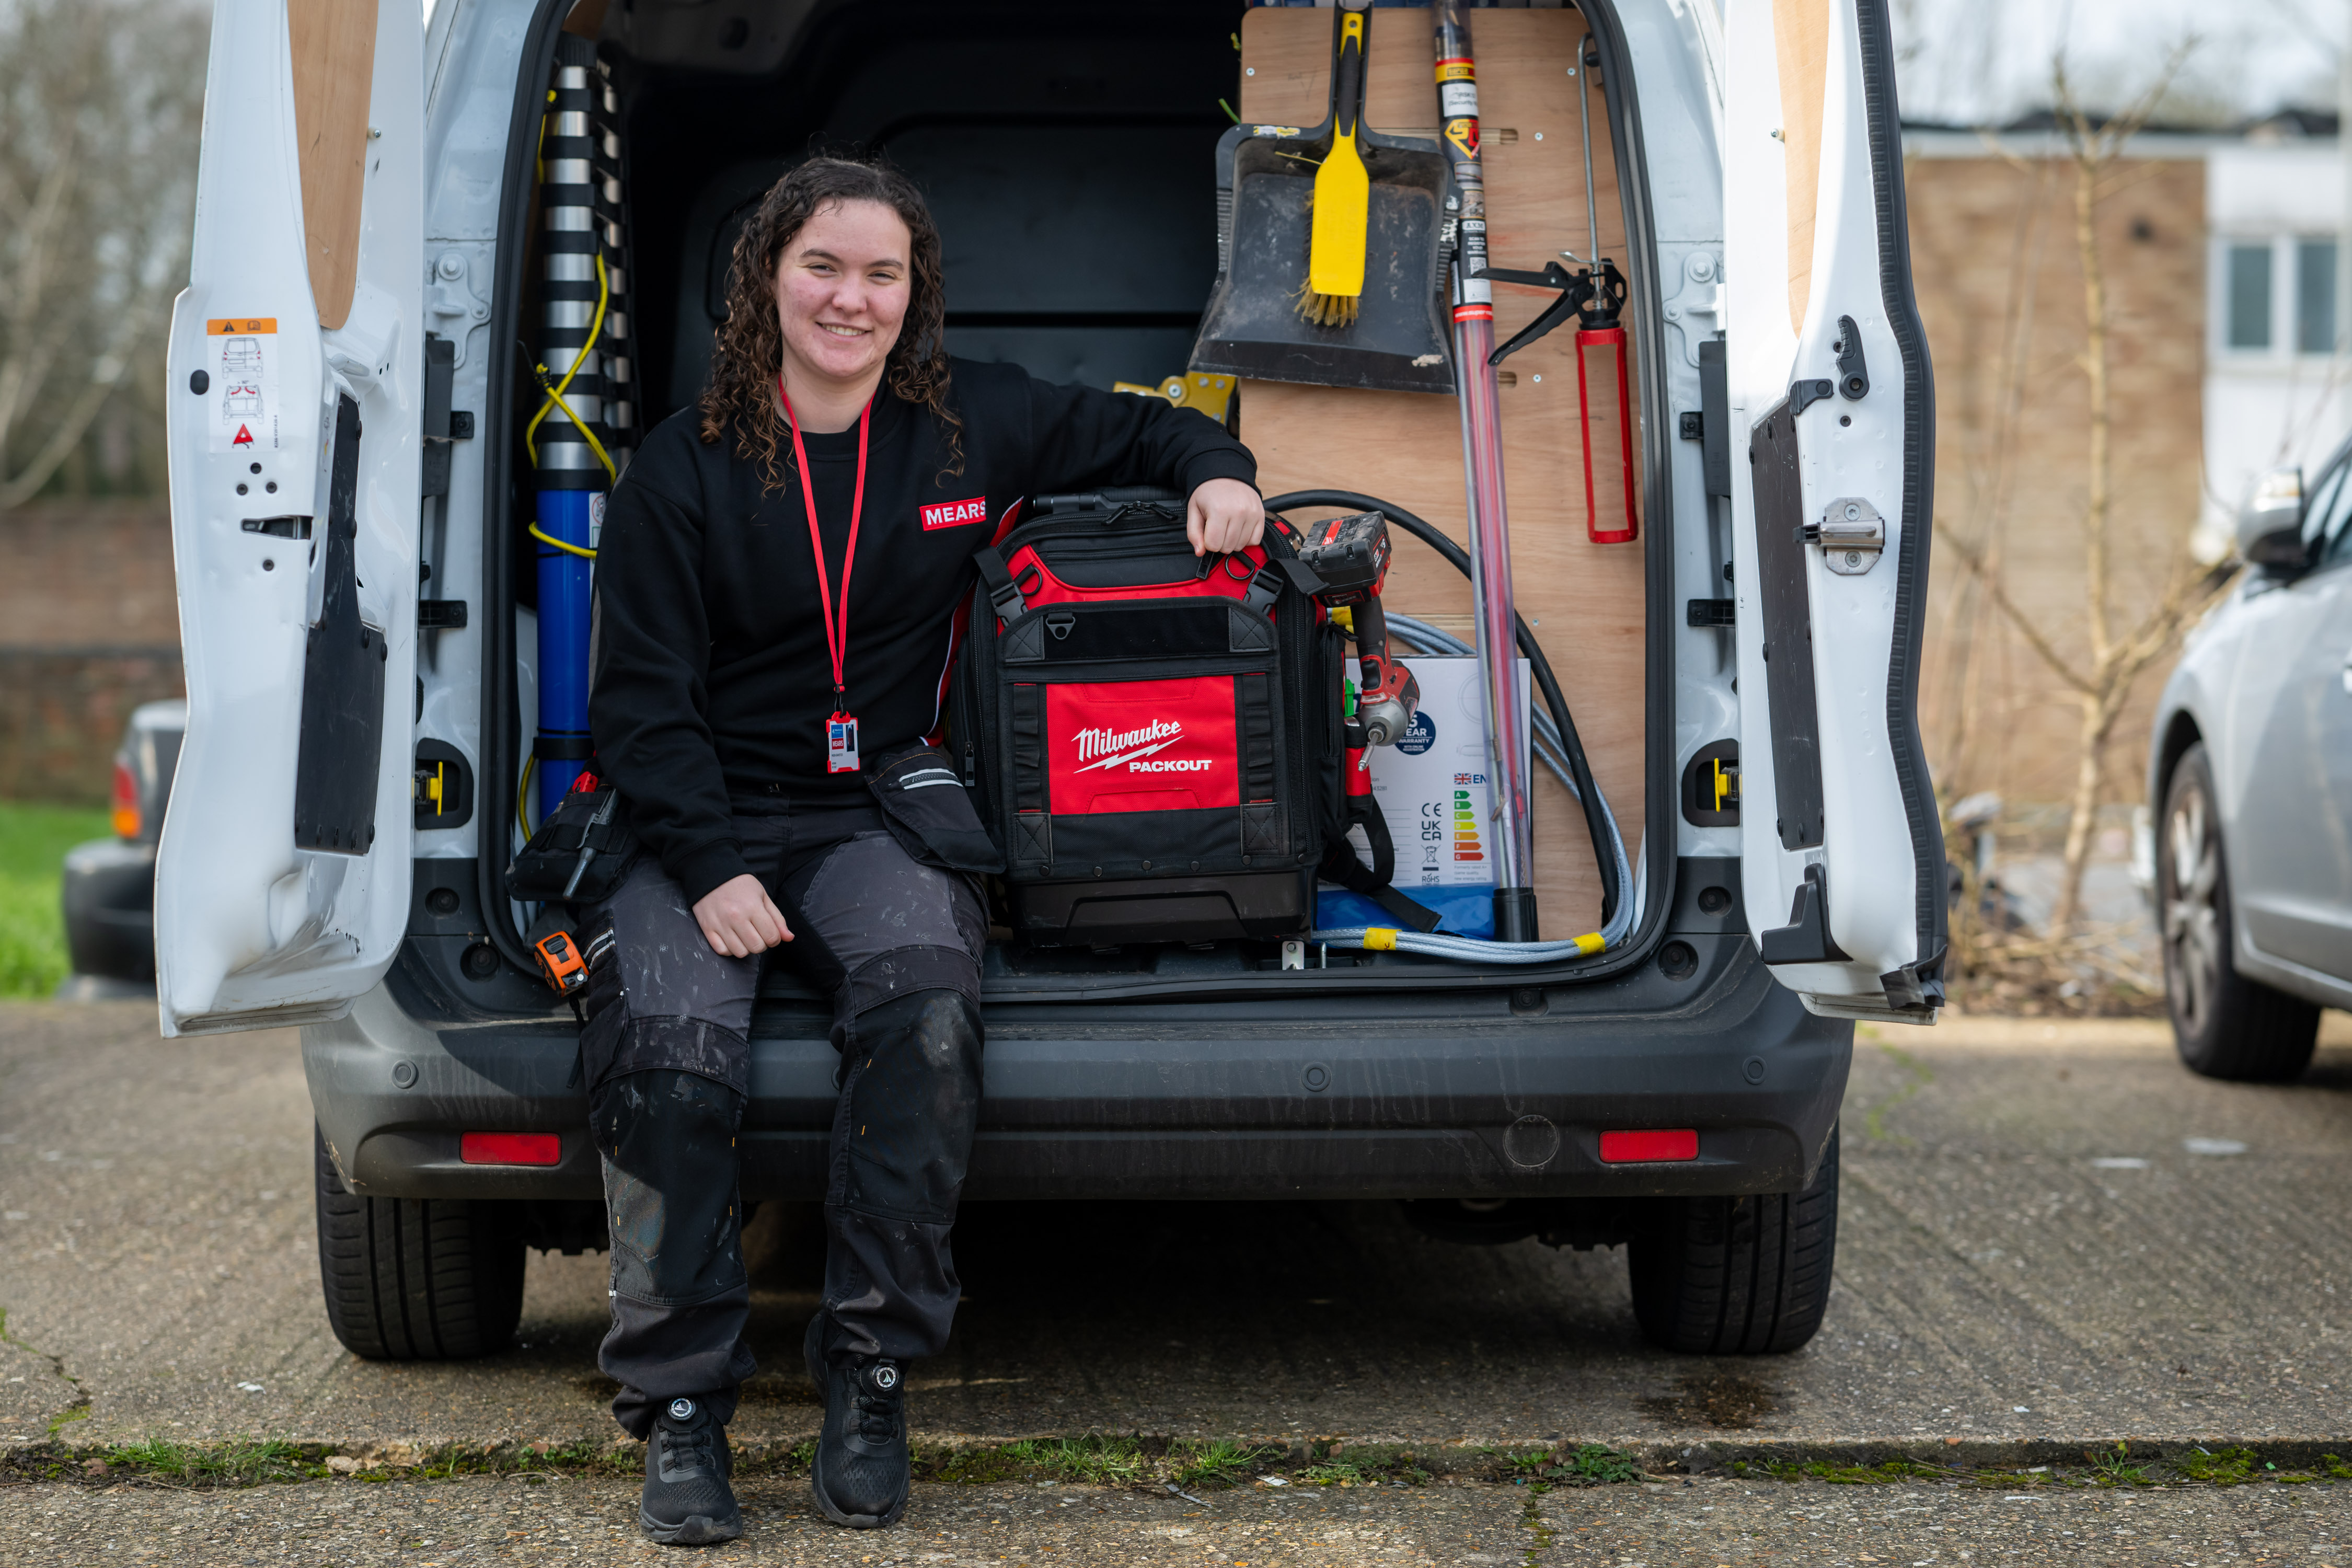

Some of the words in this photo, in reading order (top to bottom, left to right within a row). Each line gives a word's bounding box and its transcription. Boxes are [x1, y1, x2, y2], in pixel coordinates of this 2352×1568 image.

[925, 500, 986, 525] MEARS
[1405, 728, 1427, 736] EAR
[1071, 719, 1182, 762] Milwaukee
[1129, 759, 1213, 773] PACKOUT
[1422, 802, 1442, 817] CE
[1422, 821, 1441, 830] UK
[1422, 832, 1441, 840] CA
